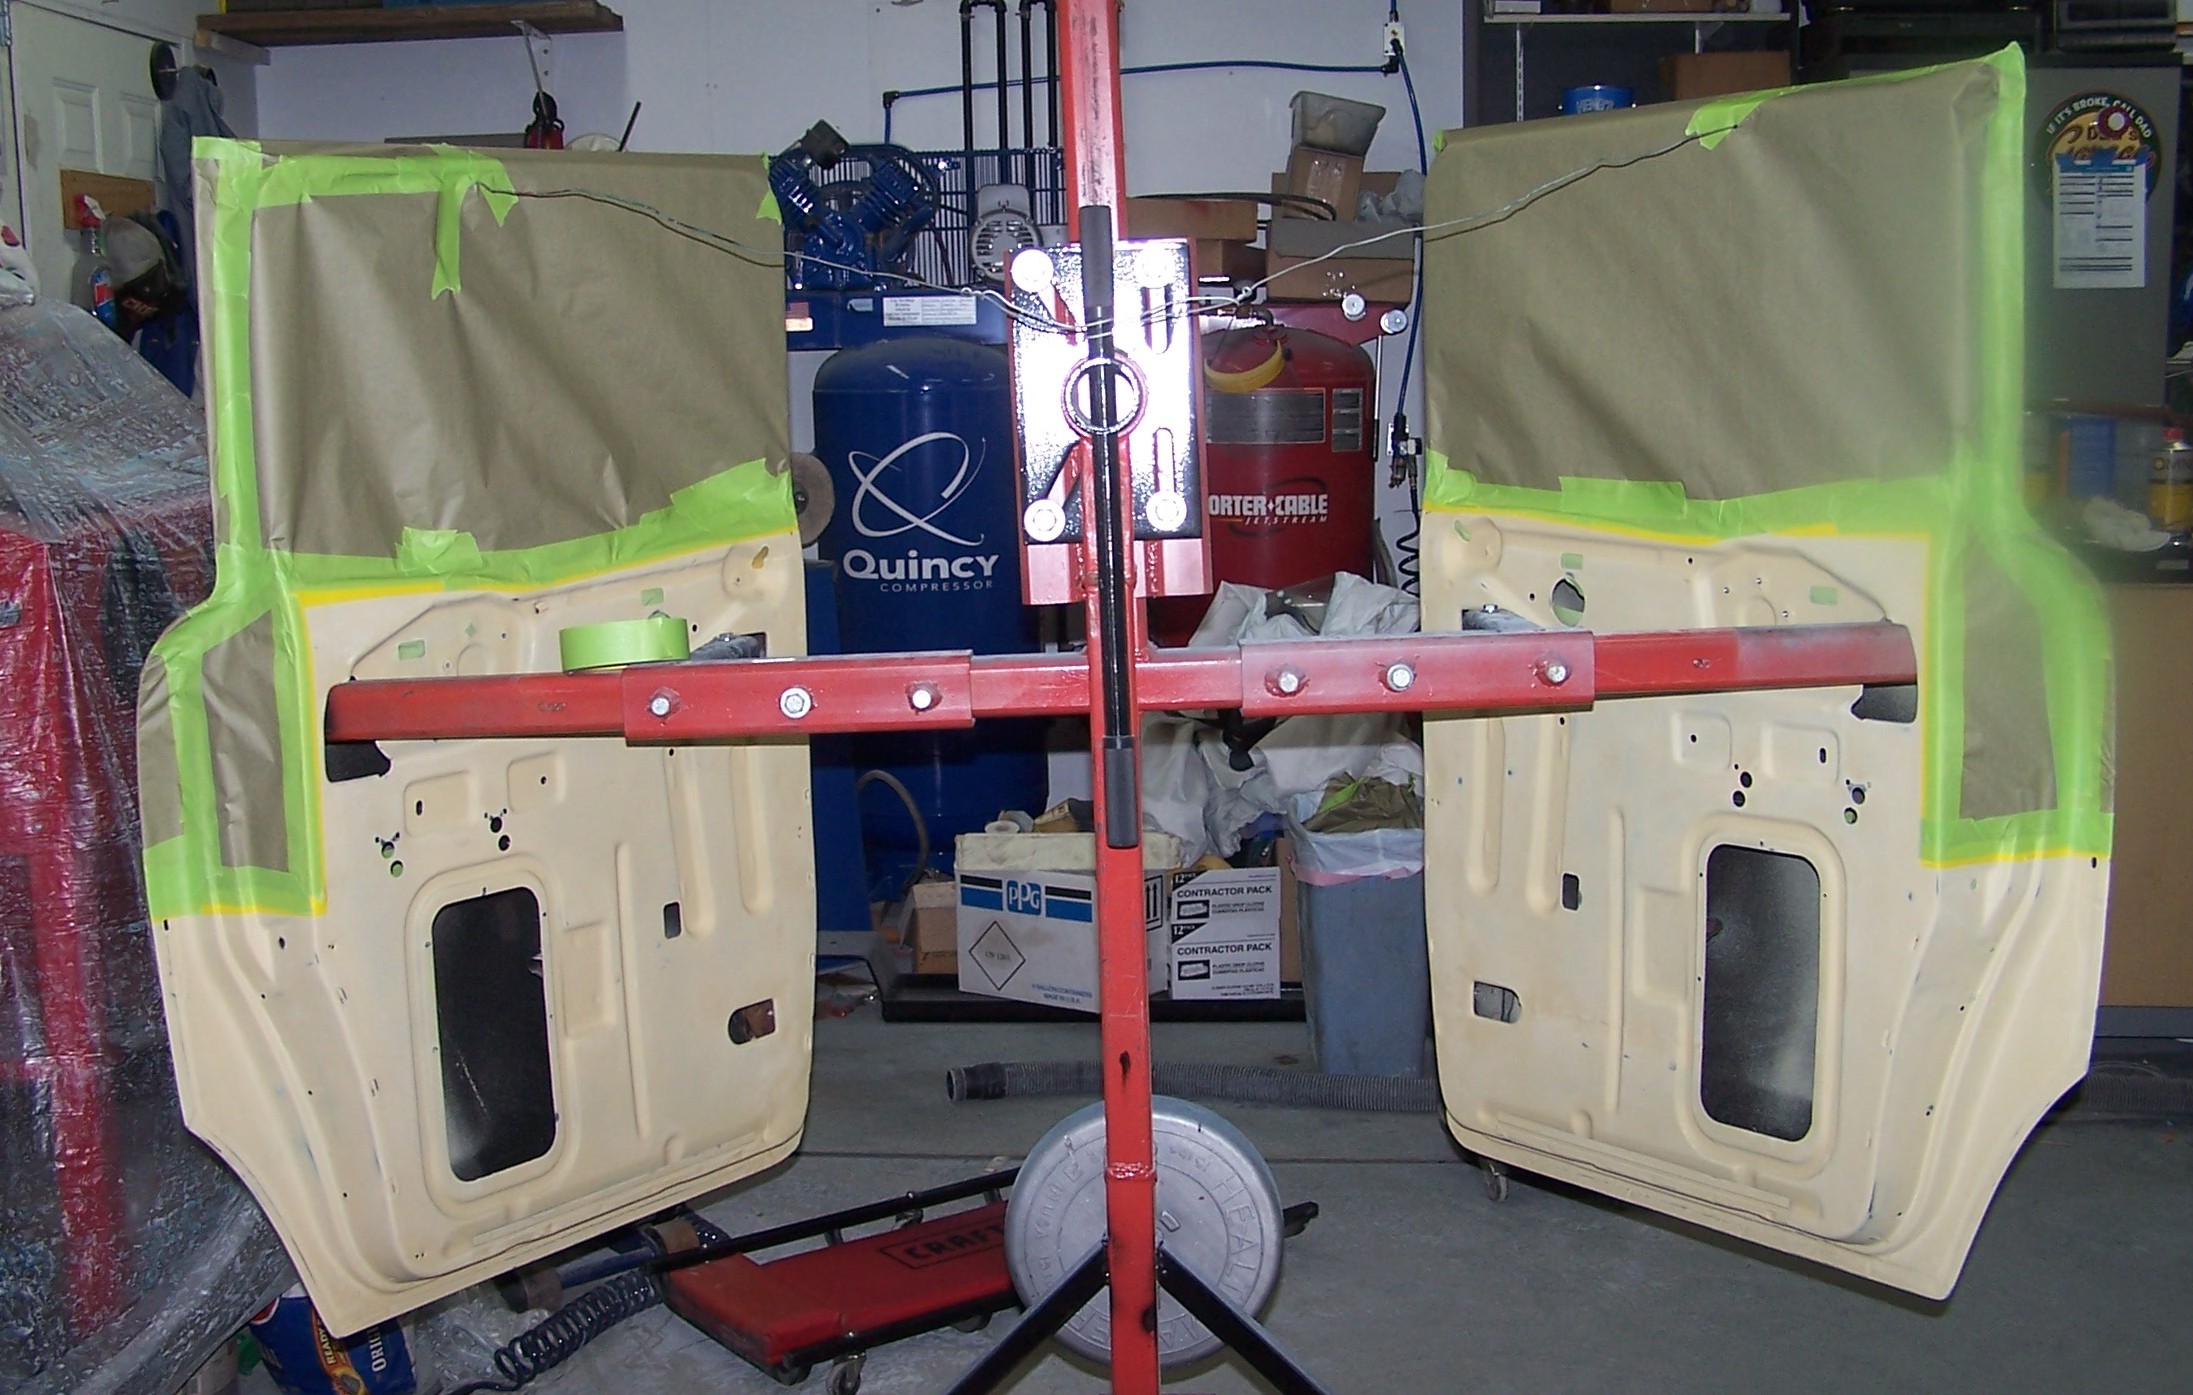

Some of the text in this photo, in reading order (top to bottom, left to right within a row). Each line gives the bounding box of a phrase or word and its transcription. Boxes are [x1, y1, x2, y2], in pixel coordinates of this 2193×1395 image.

[2045, 124, 2056, 135] IF
[2054, 106, 2072, 123] IT'S
[2072, 97, 2110, 112] BROKE,
[2135, 115, 2153, 138] DAD
[1208, 494, 1267, 516] ORTER
[880, 580, 993, 592] COMPRESSOR
[1007, 881, 1041, 912] PPG
[1177, 885, 1273, 898] CONTRACTOR PACK
[1177, 942, 1273, 956] CONTRACTOR PACK
